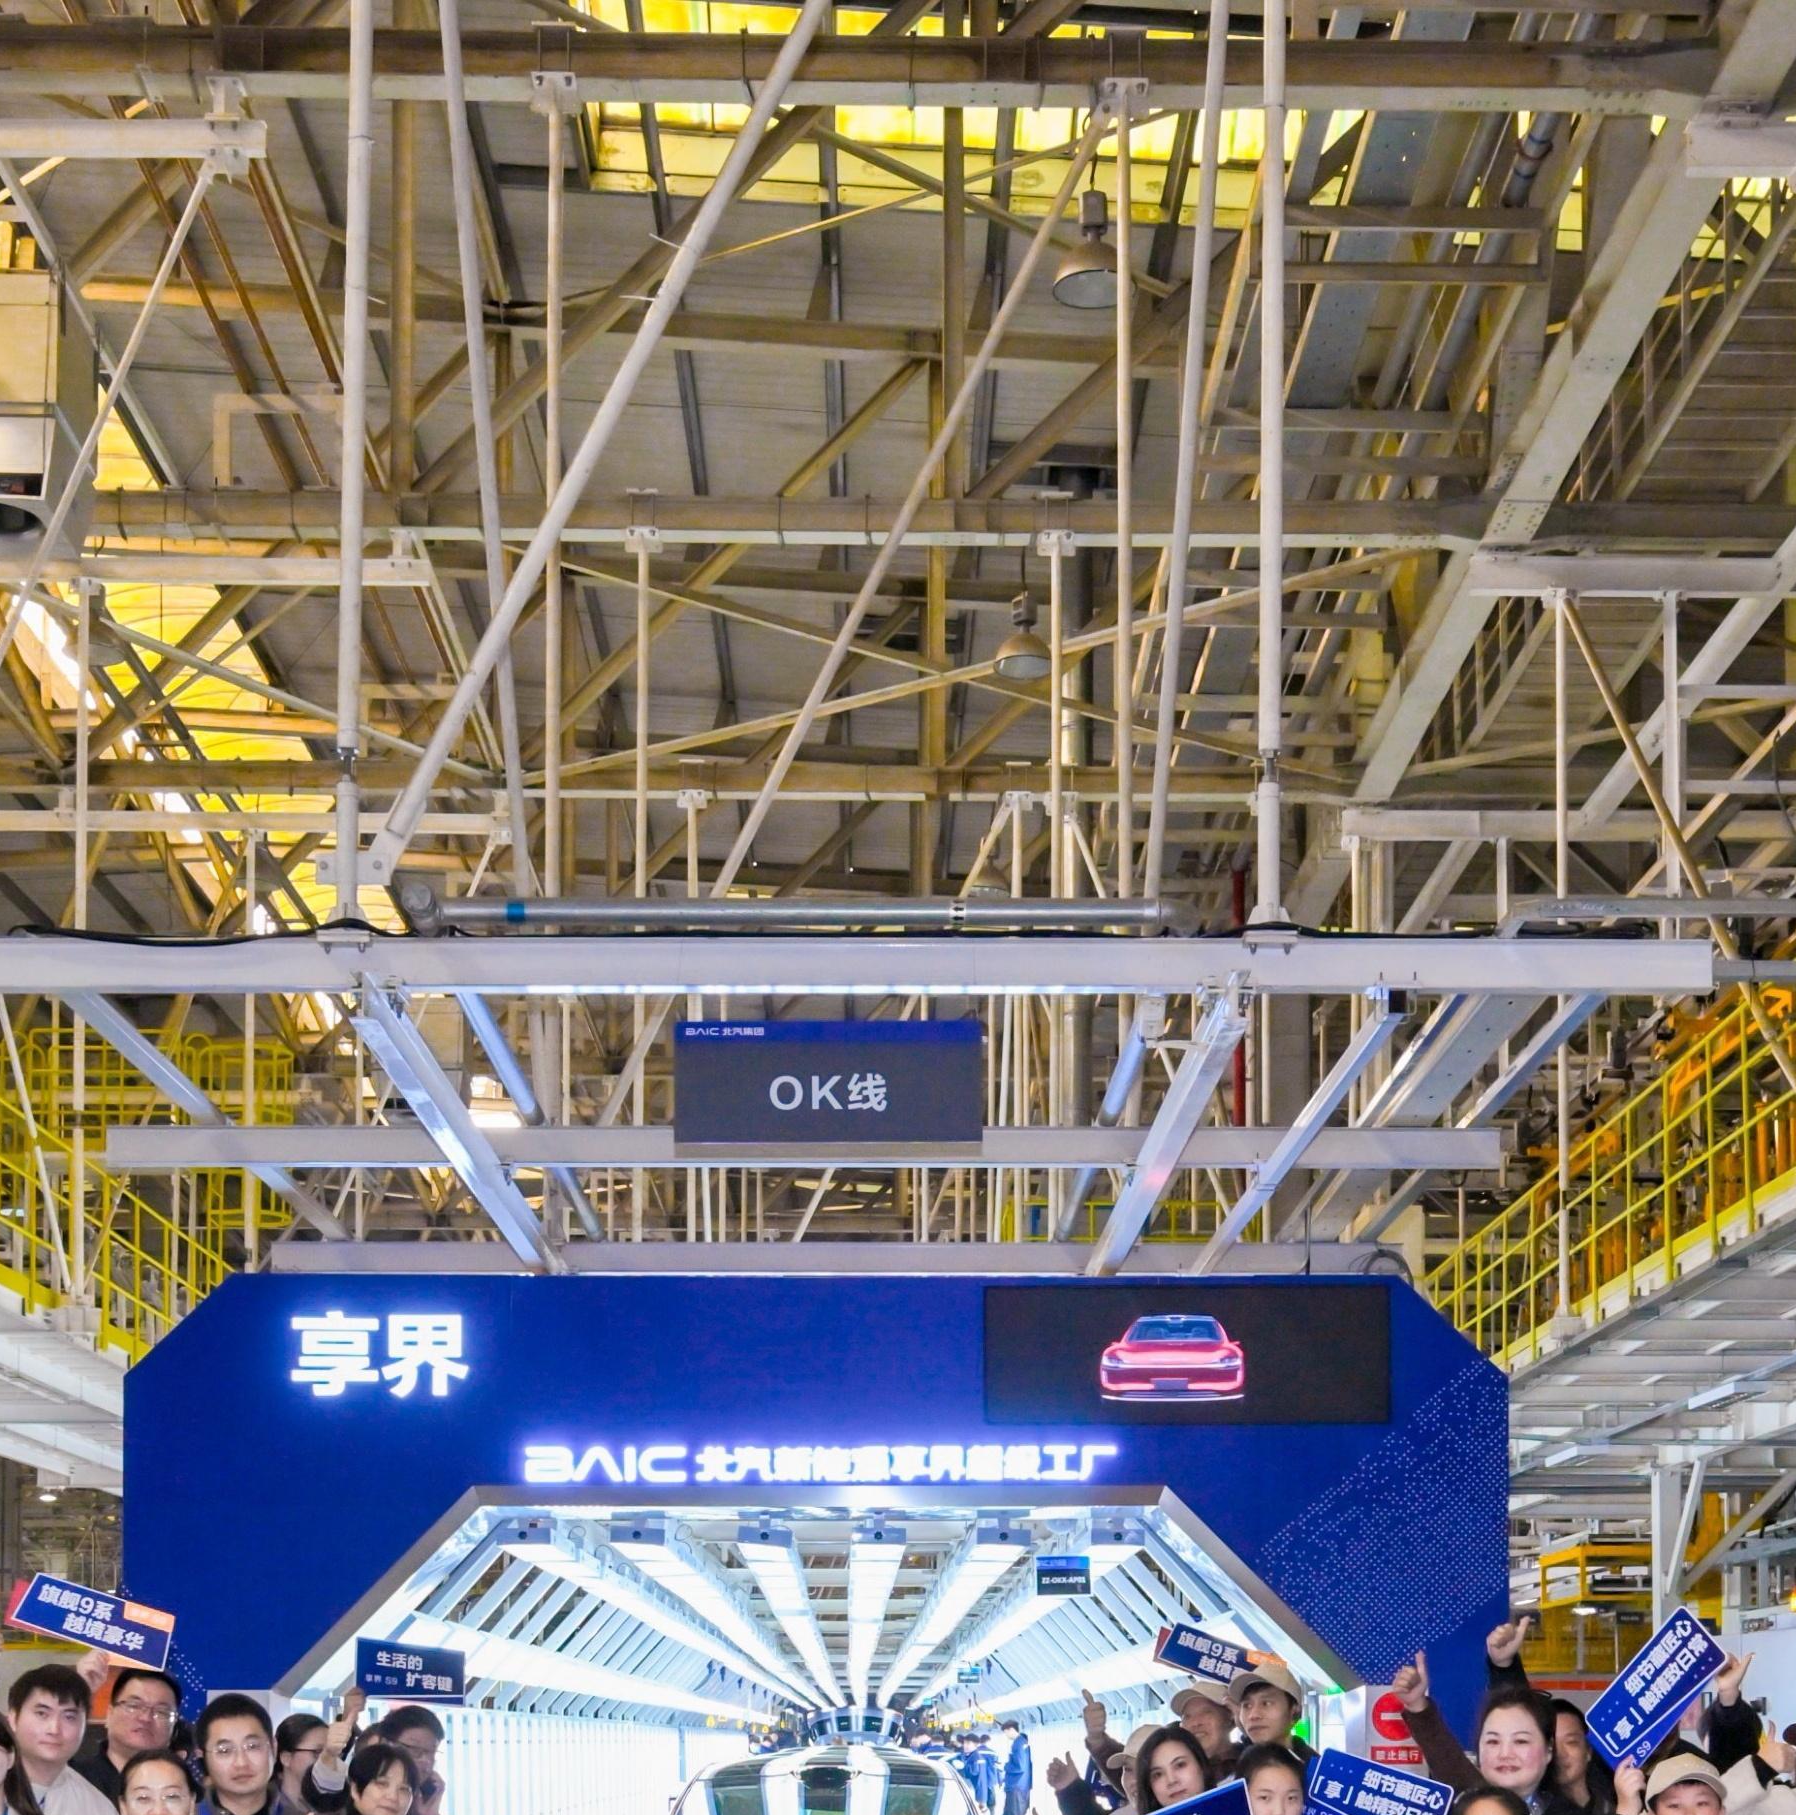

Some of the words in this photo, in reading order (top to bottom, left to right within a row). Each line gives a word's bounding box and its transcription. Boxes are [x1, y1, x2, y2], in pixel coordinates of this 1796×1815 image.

[685, 1027, 719, 1036] BAIC
[722, 1027, 765, 1036] 北汽集团
[769, 1072, 888, 1112] OK线
[290, 1310, 470, 1399] 享界
[524, 1446, 688, 1483] BAIC
[37, 1583, 115, 1622] 旗舰9系
[62, 1612, 145, 1651] 越境豪华
[1177, 1630, 1240, 1664] 旗舰9系
[375, 1650, 423, 1671] 生活的
[405, 1672, 453, 1692] 扩容键
[1636, 1740, 1652, 1758] S9
[1361, 1768, 1444, 1810] 细节藏匠心
